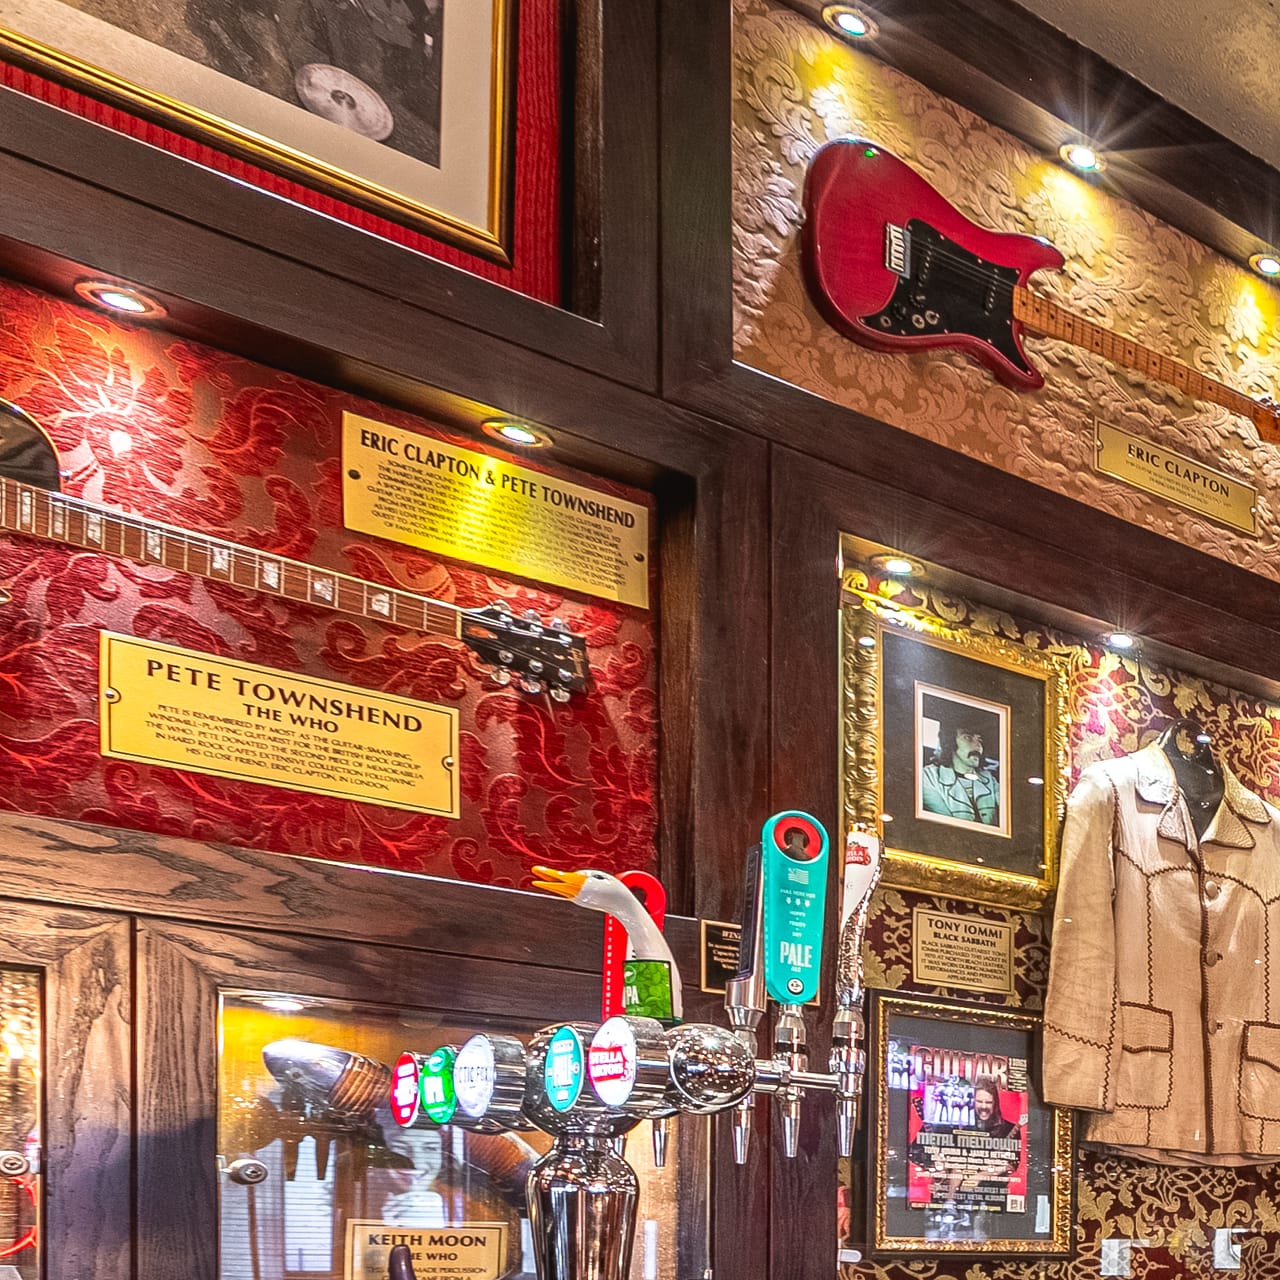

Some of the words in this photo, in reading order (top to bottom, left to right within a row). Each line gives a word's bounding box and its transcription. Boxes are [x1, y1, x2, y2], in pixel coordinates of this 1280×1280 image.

[361, 429, 399, 456] ERIC
[404, 443, 480, 480] CLAPTON
[485, 470, 495, 485] &
[502, 473, 537, 498] PETE
[541, 485, 635, 528] TOWNSHEND
[1127, 443, 1160, 467] ERIC
[1164, 460, 1230, 497] CLAPTON
[147, 659, 221, 691] PETE
[232, 677, 422, 732] TOWNSHEND
[157, 703, 180, 715] PETE
[181, 708, 190, 717] IS
[192, 710, 253, 729] REMEMBERED
[254, 722, 266, 731] BY
[269, 725, 296, 737] MOST
[299, 732, 310, 741] AS
[311, 734, 329, 745] THE
[242, 702, 282, 722] THE
[289, 713, 339, 733] WHO
[144, 719, 164, 730] THE
[197, 729, 218, 741] PETE
[221, 734, 268, 750] DONATED
[270, 743, 287, 753] THE
[289, 748, 326, 762] SECOND
[328, 755, 350, 766] PIECE
[351, 759, 362, 768] OF
[366, 762, 424, 780] MEMORABILIA
[155, 731, 165, 740] IN
[167, 733, 196, 745] HARD
[197, 739, 224, 751] ROCK
[258, 750, 305, 766] EXTENSIVE
[307, 760, 363, 777] COLLECTION
[364, 771, 416, 787] FOLLOWING
[185, 746, 200, 756] HIS
[202, 749, 232, 762] CLOSE
[270, 762, 290, 772] ERIC
[338, 774, 348, 783] IN
[243, 729, 290, 745] GUITARIST
[293, 739, 310, 750] FOR
[313, 743, 329, 753] THE
[332, 747, 363, 760] BRITISH
[364, 753, 389, 765] ROCK
[390, 758, 421, 771] GROUP
[928, 918, 961, 932] TONY
[964, 924, 1002, 939] IOMMI
[933, 932, 959, 942] BLACK
[961, 936, 996, 948] SABBATH
[779, 941, 812, 968] PALE
[913, 1045, 1008, 1090] GUITAR
[916, 1132, 954, 1146] METAL
[368, 1234, 422, 1247] KEITH
[428, 1235, 487, 1247] MOON
[426, 1253, 458, 1262] WHO
